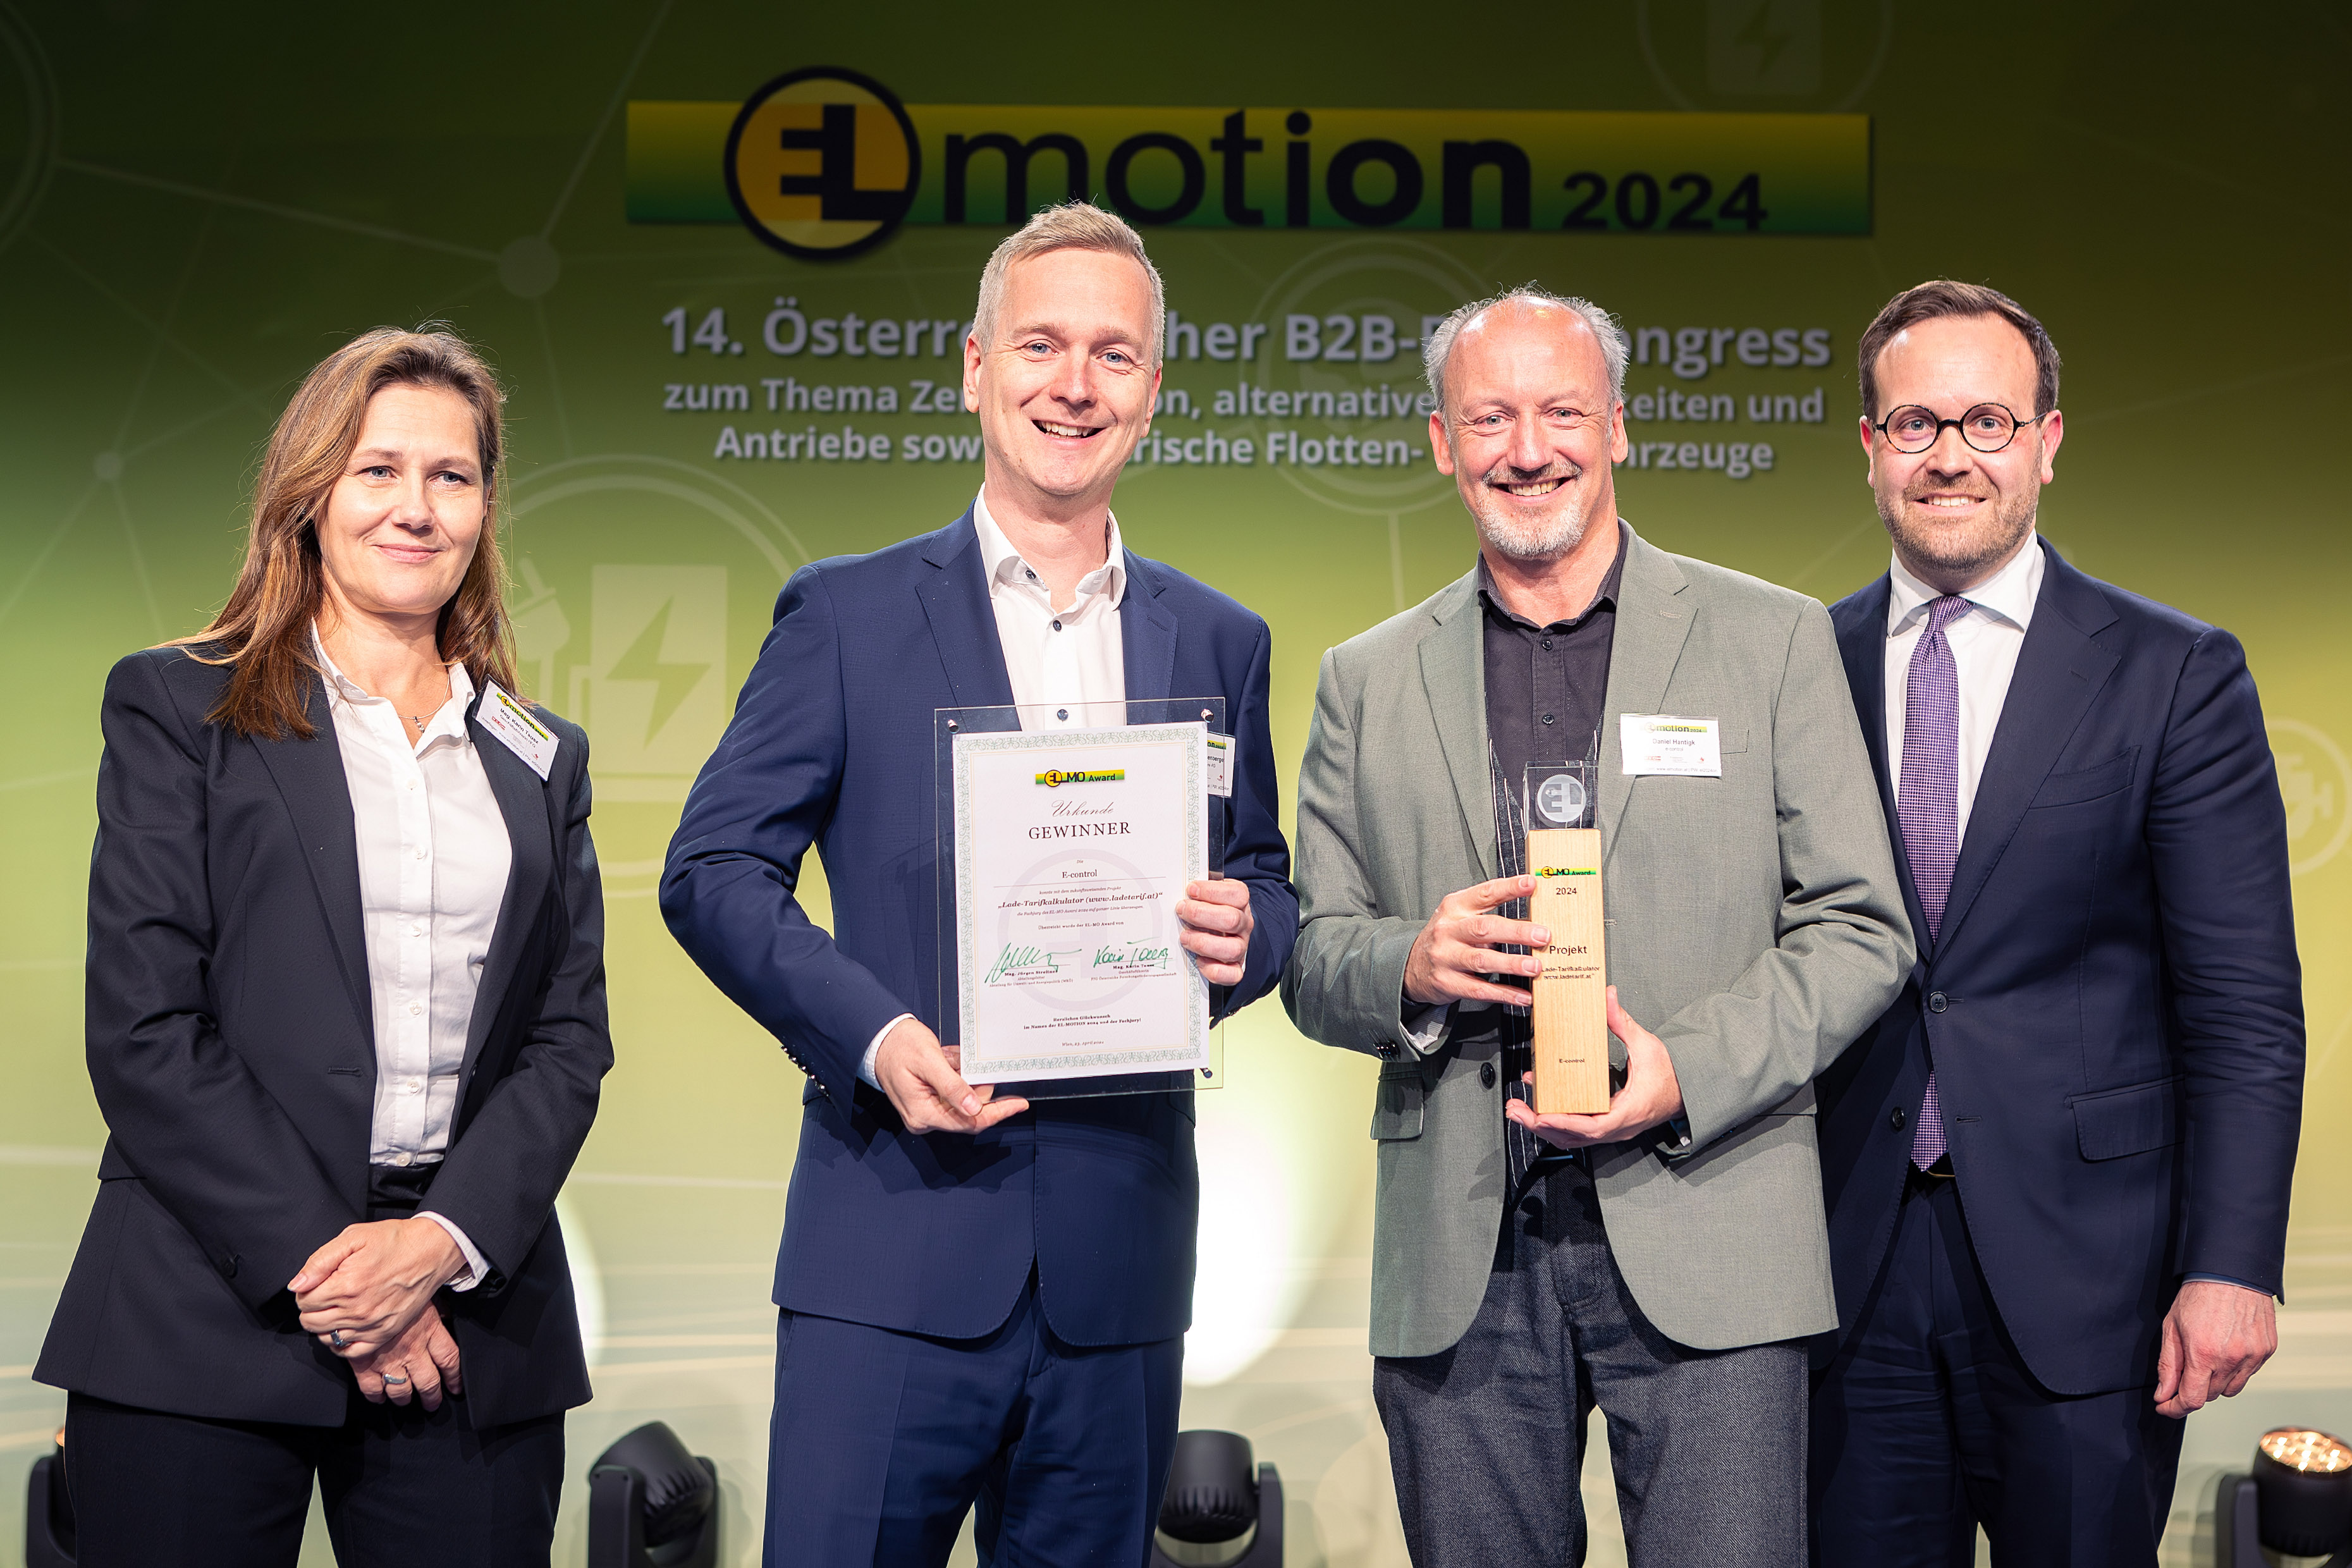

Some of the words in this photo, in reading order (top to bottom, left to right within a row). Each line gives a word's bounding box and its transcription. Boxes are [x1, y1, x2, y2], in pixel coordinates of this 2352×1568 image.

[944, 109, 1531, 230] motion
[1562, 171, 1767, 231] 2024
[662, 307, 744, 356] 14.
[763, 295, 970, 358] Österr
[663, 383, 749, 412] zum
[760, 377, 898, 413] Thema
[1747, 386, 1824, 423] und
[714, 425, 891, 461] Antriebe
[902, 432, 985, 462] sow
[1134, 429, 1254, 465] rische
[1266, 431, 1424, 467] Flotten-
[500, 707, 511, 720] Mag.
[511, 718, 524, 732] Karin
[509, 704, 536, 731] motion
[1088, 773, 1116, 782] Award
[1051, 799, 1114, 818] Urkunde
[1028, 821, 1131, 840] GEWINNER
[1062, 869, 1098, 878] E-control
[1555, 887, 1577, 895] 2024
[998, 897, 1084, 909] „Lade-Tarifkalkulator
[1549, 945, 1588, 957] Projekt
